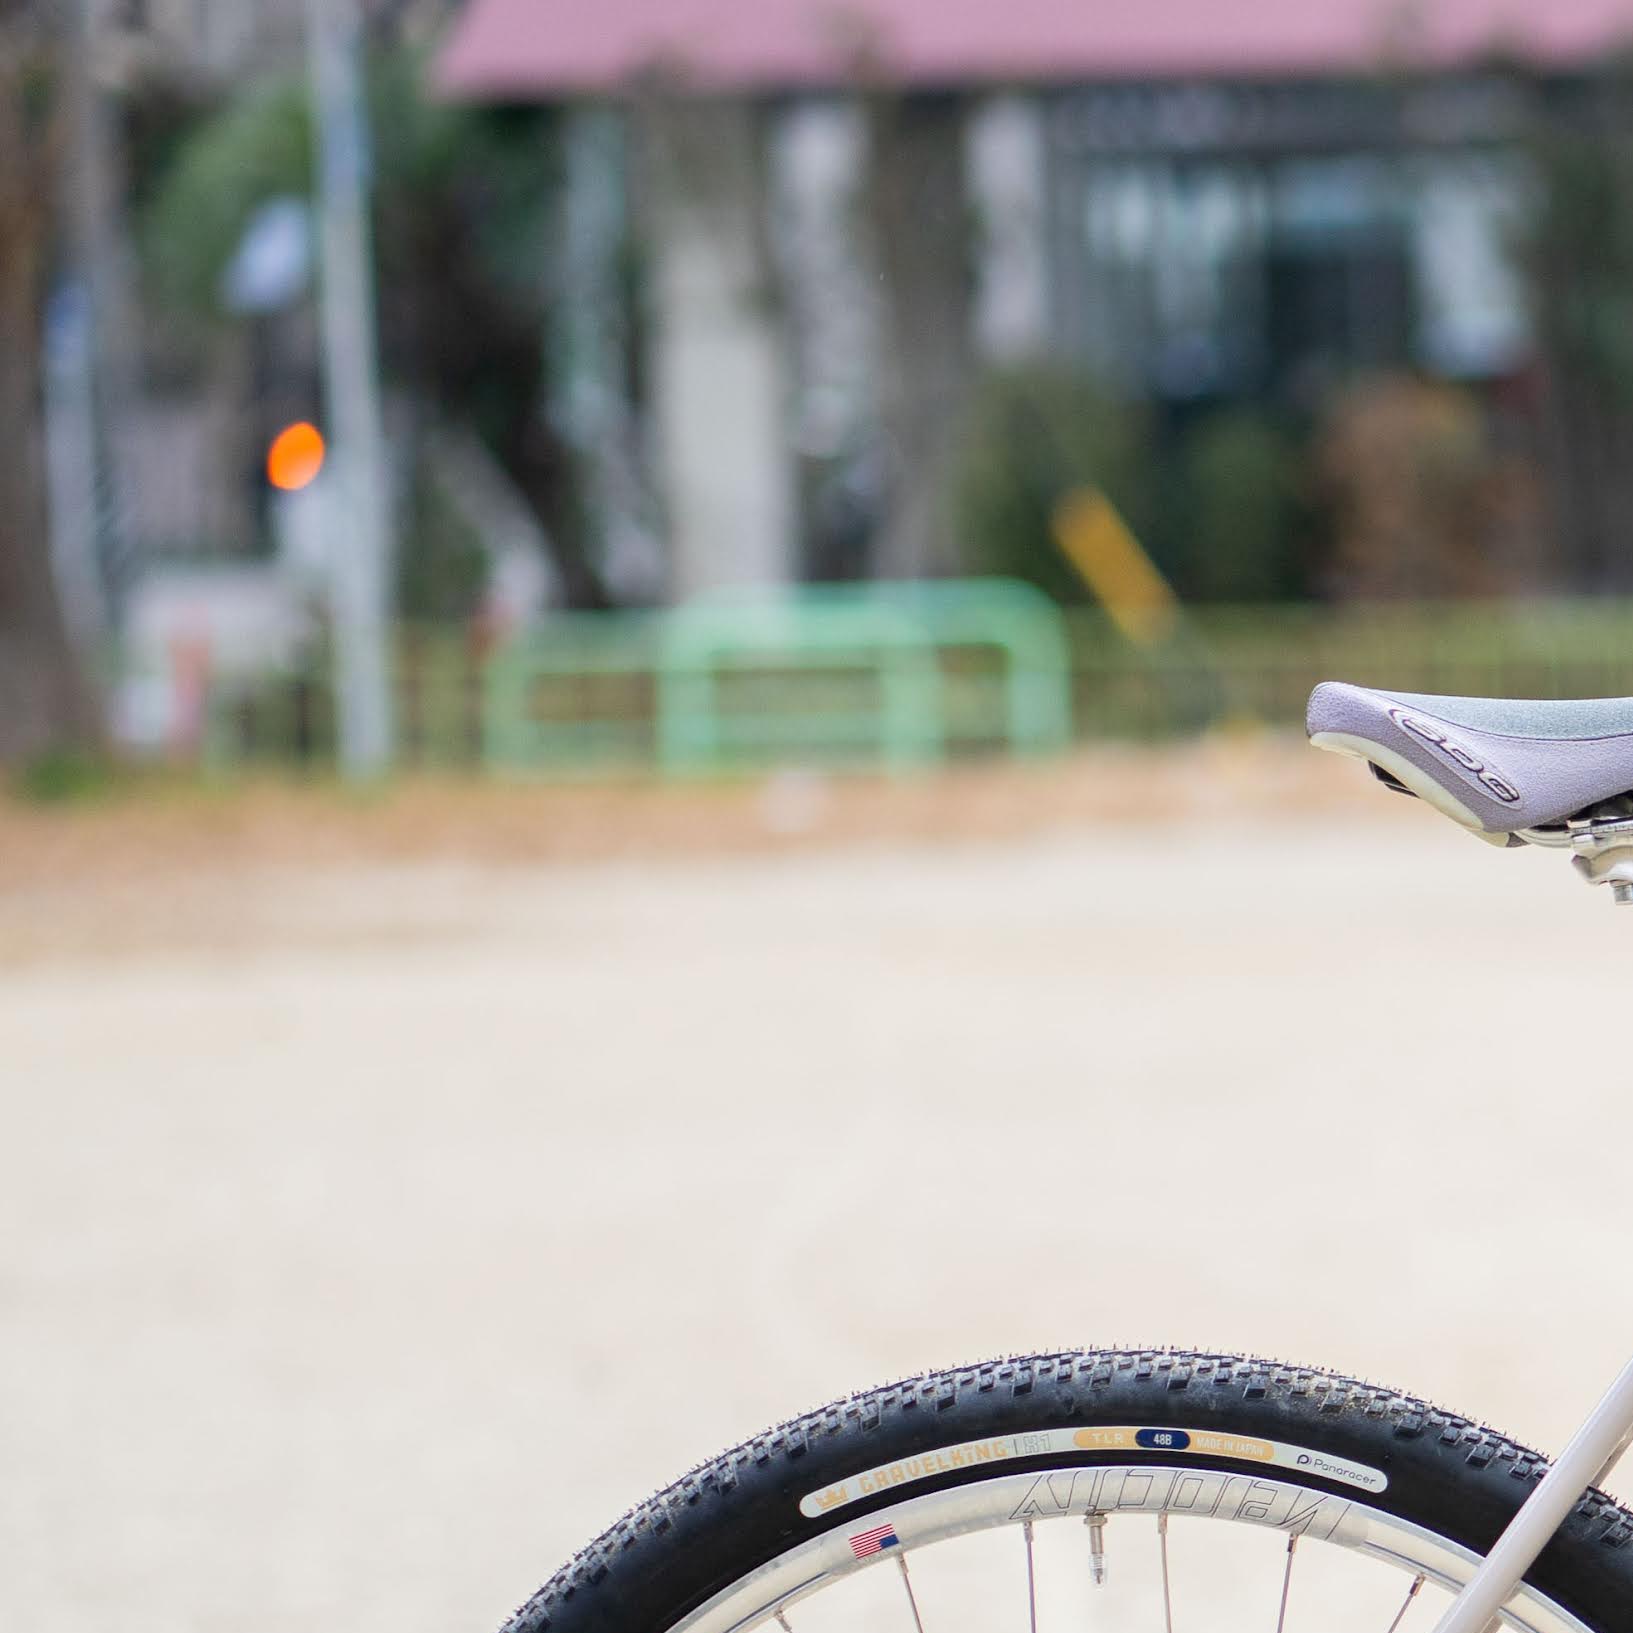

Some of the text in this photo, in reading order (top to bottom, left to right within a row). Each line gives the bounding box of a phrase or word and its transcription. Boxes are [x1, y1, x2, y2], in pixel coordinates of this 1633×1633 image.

[1092, 1432, 1124, 1444] TLR
[1153, 1432, 1173, 1446] 48B
[1196, 1436, 1223, 1450] MADE
[1235, 1440, 1265, 1457] JAPAN
[858, 1438, 1008, 1495] GRAVELKING
[1314, 1458, 1377, 1486] Panaracer
